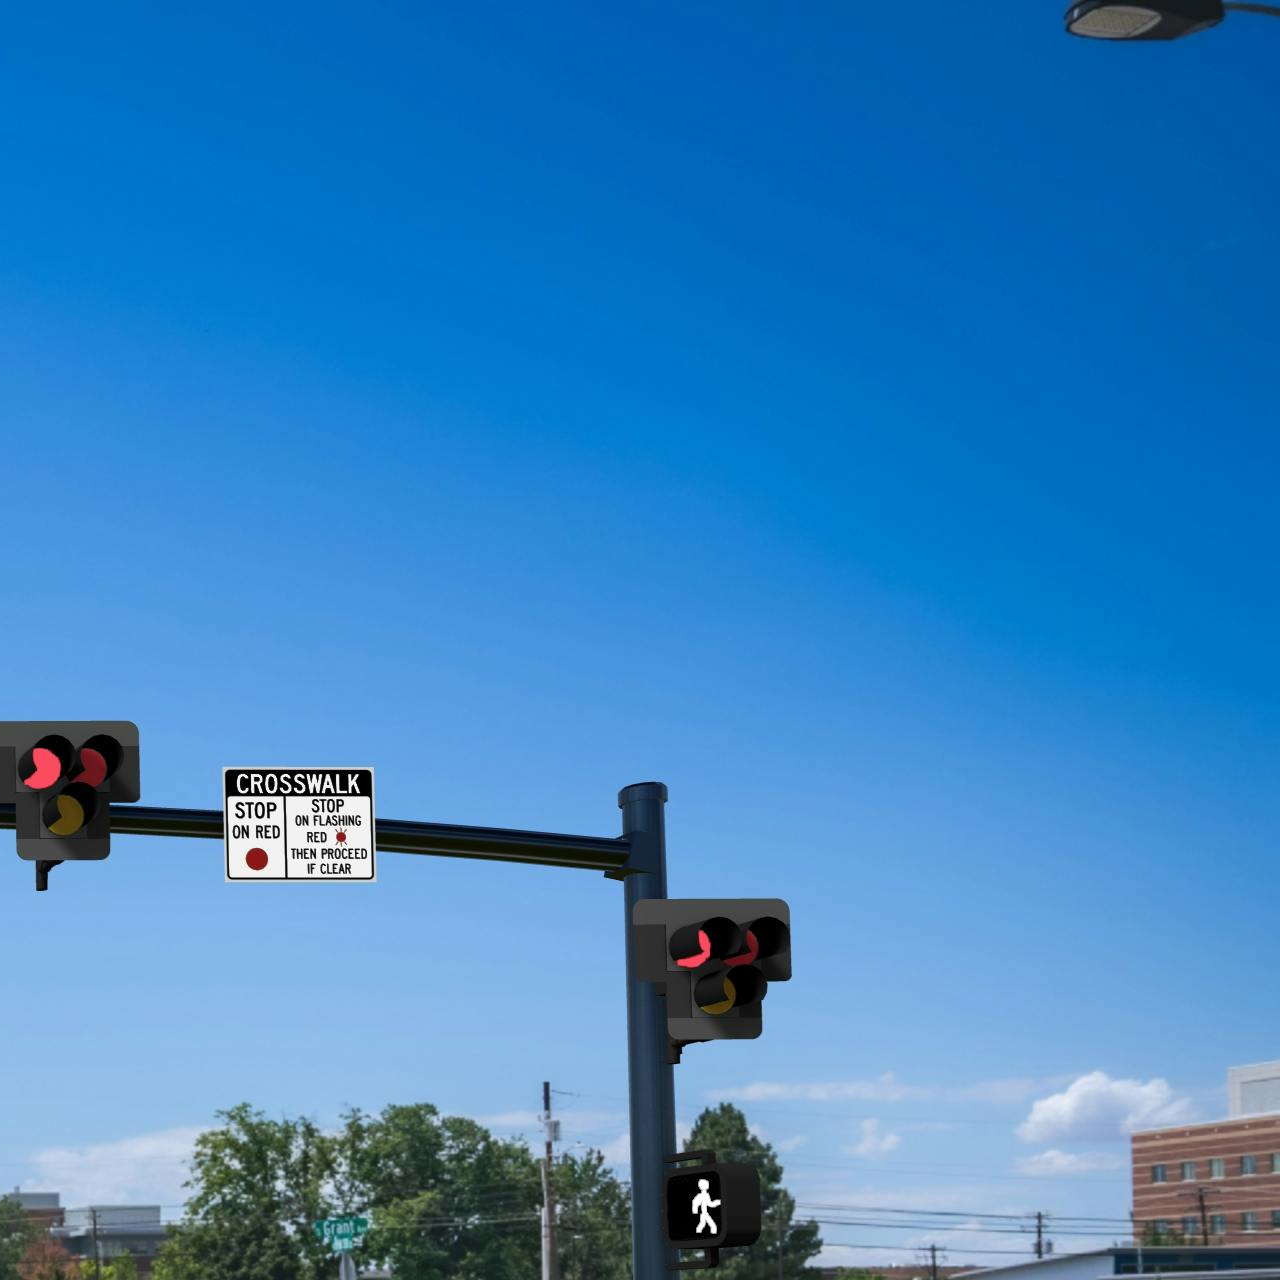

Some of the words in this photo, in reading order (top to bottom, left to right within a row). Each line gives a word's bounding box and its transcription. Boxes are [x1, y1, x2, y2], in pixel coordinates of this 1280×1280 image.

[236, 773, 361, 794] CROSSWALK
[234, 801, 278, 820] STOP
[311, 798, 345, 813] STOP
[295, 814, 310, 827] ON
[313, 814, 362, 827] FLASHING
[232, 824, 250, 839] ON
[255, 824, 281, 839] RED
[306, 831, 328, 843] RED
[291, 847, 317, 860] THEN
[321, 847, 368, 860] PROCEED
[307, 863, 317, 875] IF
[320, 863, 352, 875] CLEAR
